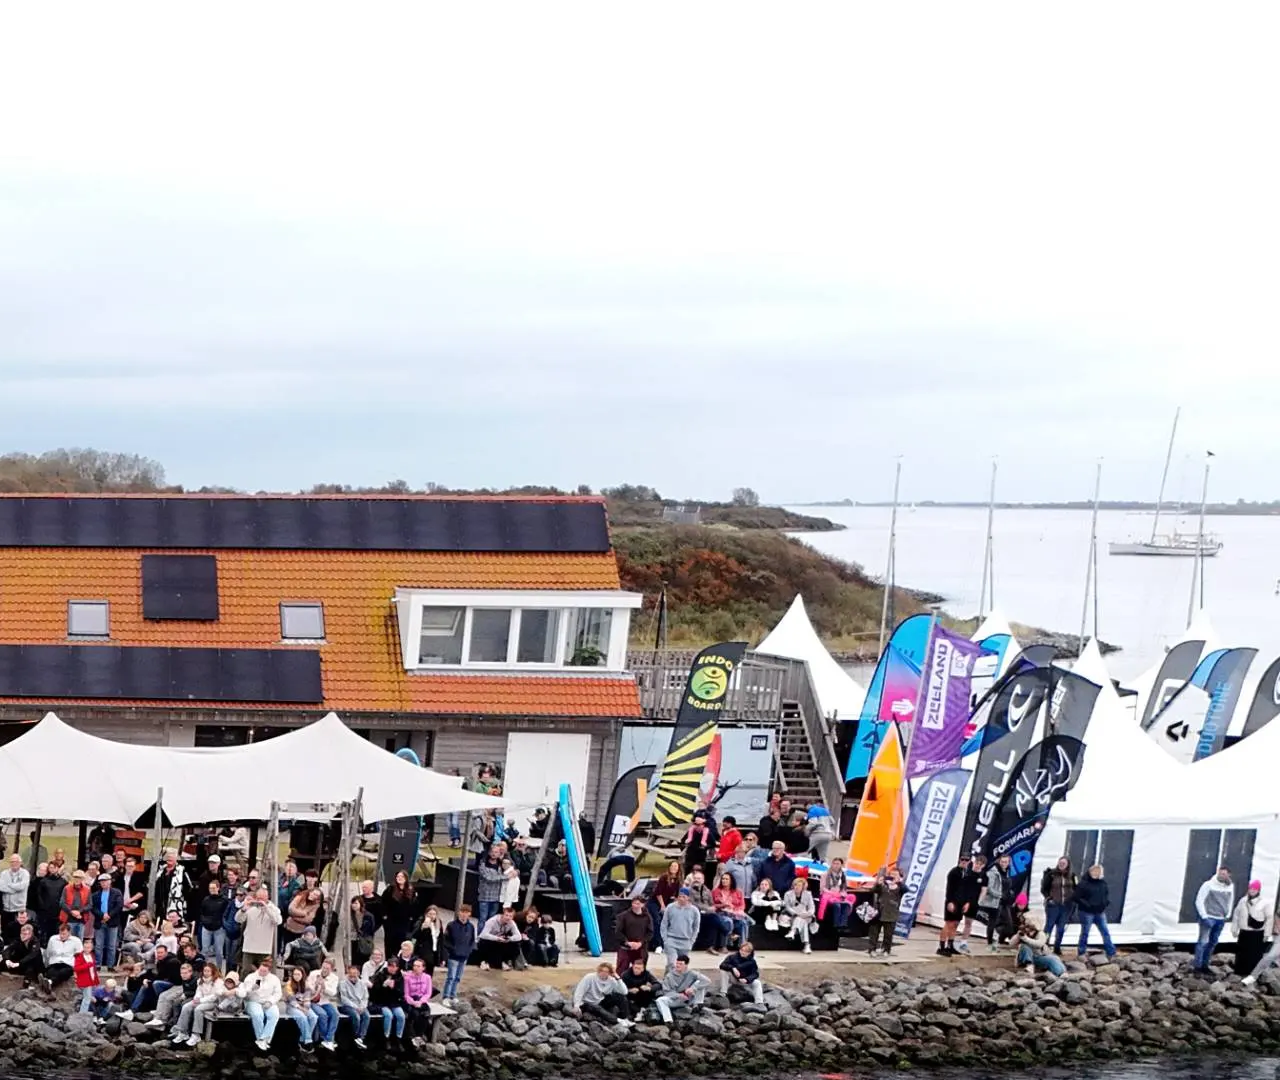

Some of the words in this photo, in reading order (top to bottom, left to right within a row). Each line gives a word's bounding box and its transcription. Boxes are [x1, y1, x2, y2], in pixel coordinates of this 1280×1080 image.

[698, 655, 734, 671] INDO
[927, 643, 948, 725] ZEELAND
[687, 696, 723, 710] BOARD
[1199, 681, 1232, 755] DUOTONE
[902, 786, 950, 910] ZEELAND.COM
